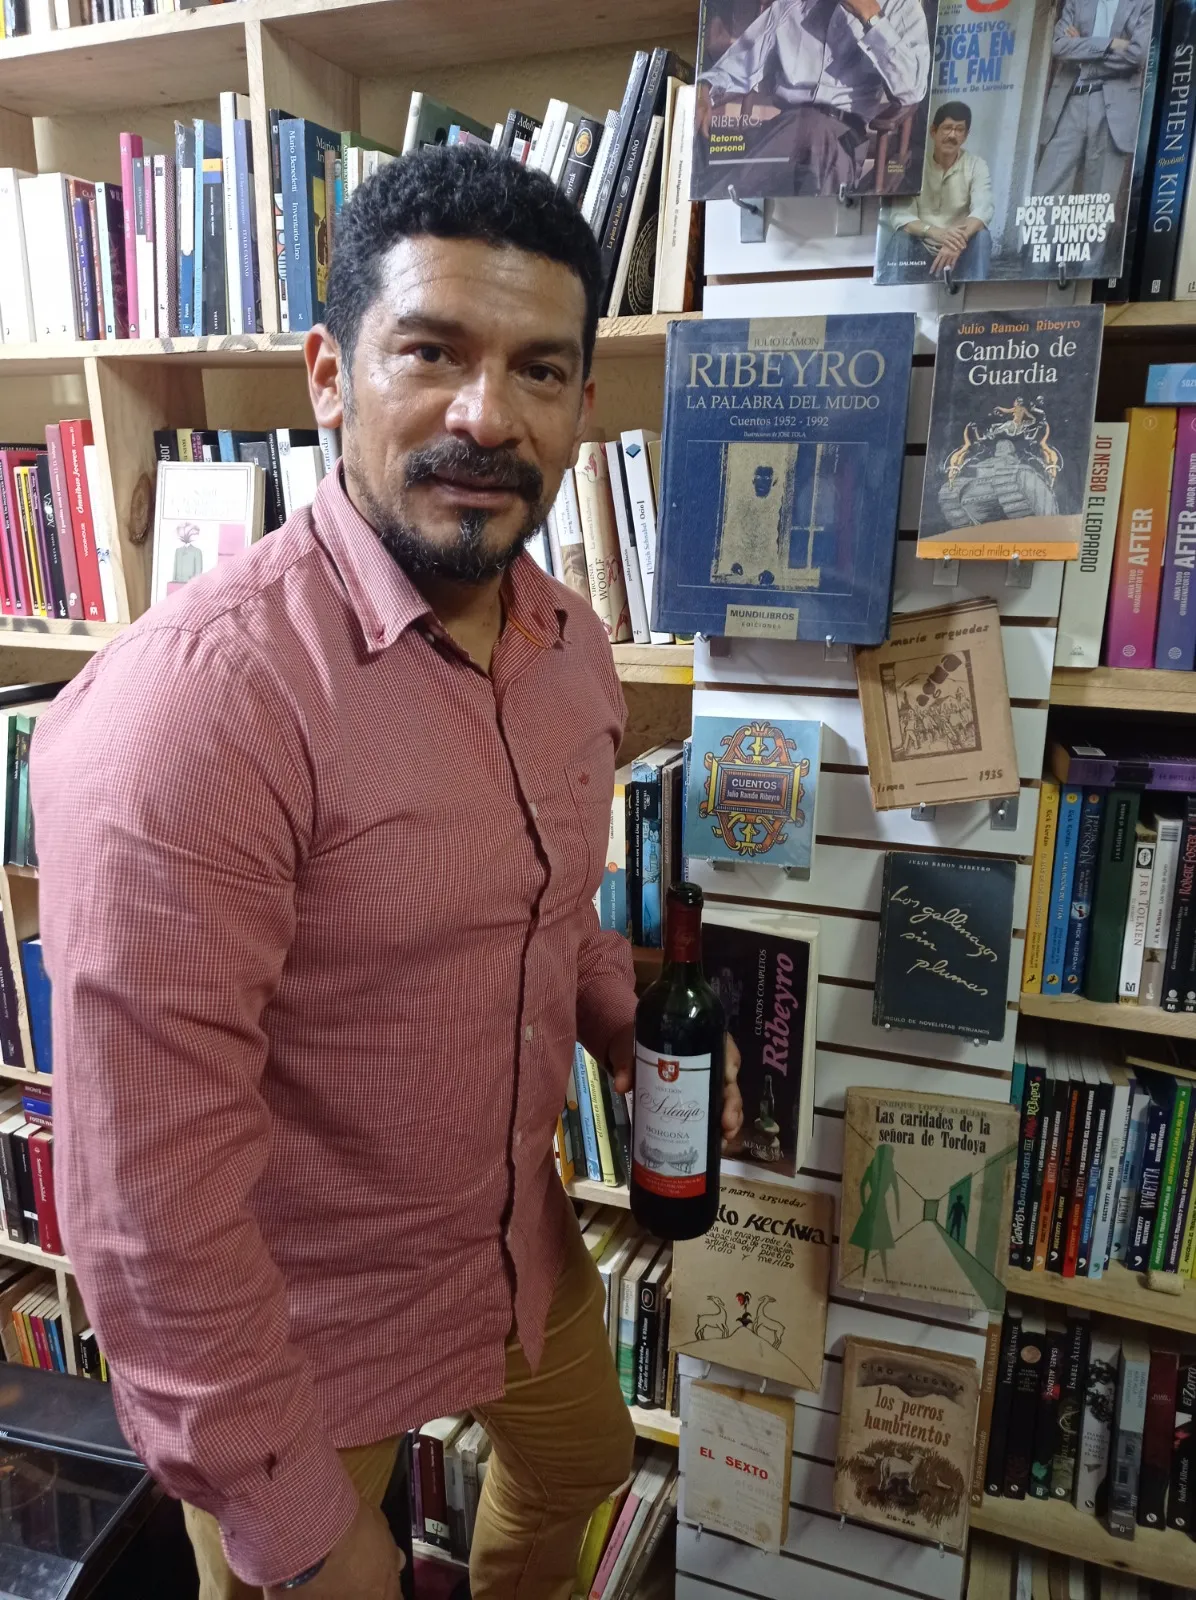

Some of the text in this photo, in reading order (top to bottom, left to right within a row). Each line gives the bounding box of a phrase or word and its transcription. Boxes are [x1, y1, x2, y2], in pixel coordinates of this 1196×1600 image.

[989, 30, 1016, 56] EN
[938, 57, 1002, 85] EL FMI
[709, 143, 745, 154] personal
[710, 134, 744, 143] Retorno
[1153, 44, 1194, 234] STEPHEN KING
[627, 138, 640, 171] BOLAÑO
[289, 130, 301, 260] Mario Benedetti Inventario Uno
[1024, 193, 1111, 206] BRYCE Y RIBEYRO
[1016, 203, 1116, 226] POR PRIMERA
[1022, 224, 1107, 244] VEZ JUNTOS
[1032, 243, 1091, 263] EN LIMA
[958, 319, 1081, 335] Julio Ramón Ribeyro
[754, 338, 780, 347] JULIO
[956, 335, 1077, 362] Cambio de
[686, 350, 885, 389] RIBEYRO
[968, 363, 1058, 386] Guardia
[686, 395, 880, 410] LA PALABRA DEL MUDO
[730, 415, 829, 427] Cuentos 1952 1992
[1095, 435, 1113, 450] JO
[1087, 496, 1106, 510] EL
[1127, 507, 1154, 567] AFTER
[1174, 508, 1196, 570] AFTER
[1186, 481, 1196, 508] AMOR
[942, 543, 985, 557] editorial
[986, 543, 1011, 557] milla
[1080, 512, 1104, 573] LEOPARDO
[588, 562, 596, 598] VIRGINIA
[595, 558, 608, 601] WOOLF
[730, 609, 795, 621] MUNDILIBROS
[934, 623, 990, 642] arguedas
[731, 778, 778, 790] CUENTOS
[979, 768, 1003, 782] 1935
[727, 790, 739, 799] Julio
[760, 792, 780, 804] Ribeyro
[1179, 864, 1194, 895] ROBERT
[910, 908, 998, 963] gallinazos
[1132, 900, 1149, 948] TOLKIEN
[900, 931, 938, 951] sin
[906, 959, 989, 997] plumas
[755, 949, 768, 1036] CUENTOS COMPLETOS
[763, 952, 798, 1077] Ribeyro
[919, 1019, 956, 1031] NOVELISTAS
[1027, 1079, 1041, 1117] REBELDES
[645, 1124, 690, 1140] BORGOÑA
[875, 1107, 991, 1136] Las caridades de la
[879, 1126, 986, 1155] señora de Tordoya
[728, 1188, 755, 1199] maria
[1140, 1166, 1160, 1209] WIGETTA
[741, 1242, 755, 1254] del
[760, 1248, 791, 1262] pueblo
[1003, 1325, 1019, 1385] ISABEL ALLENDE
[1067, 1326, 1083, 1390] ISABEL ALLENDE
[861, 1361, 894, 1376] CIRO
[874, 1386, 945, 1423] los perros
[863, 1409, 952, 1448] hambrientos
[699, 1446, 769, 1481] EL SEXTO
[886, 1513, 916, 1528] ZIG-ZAG
